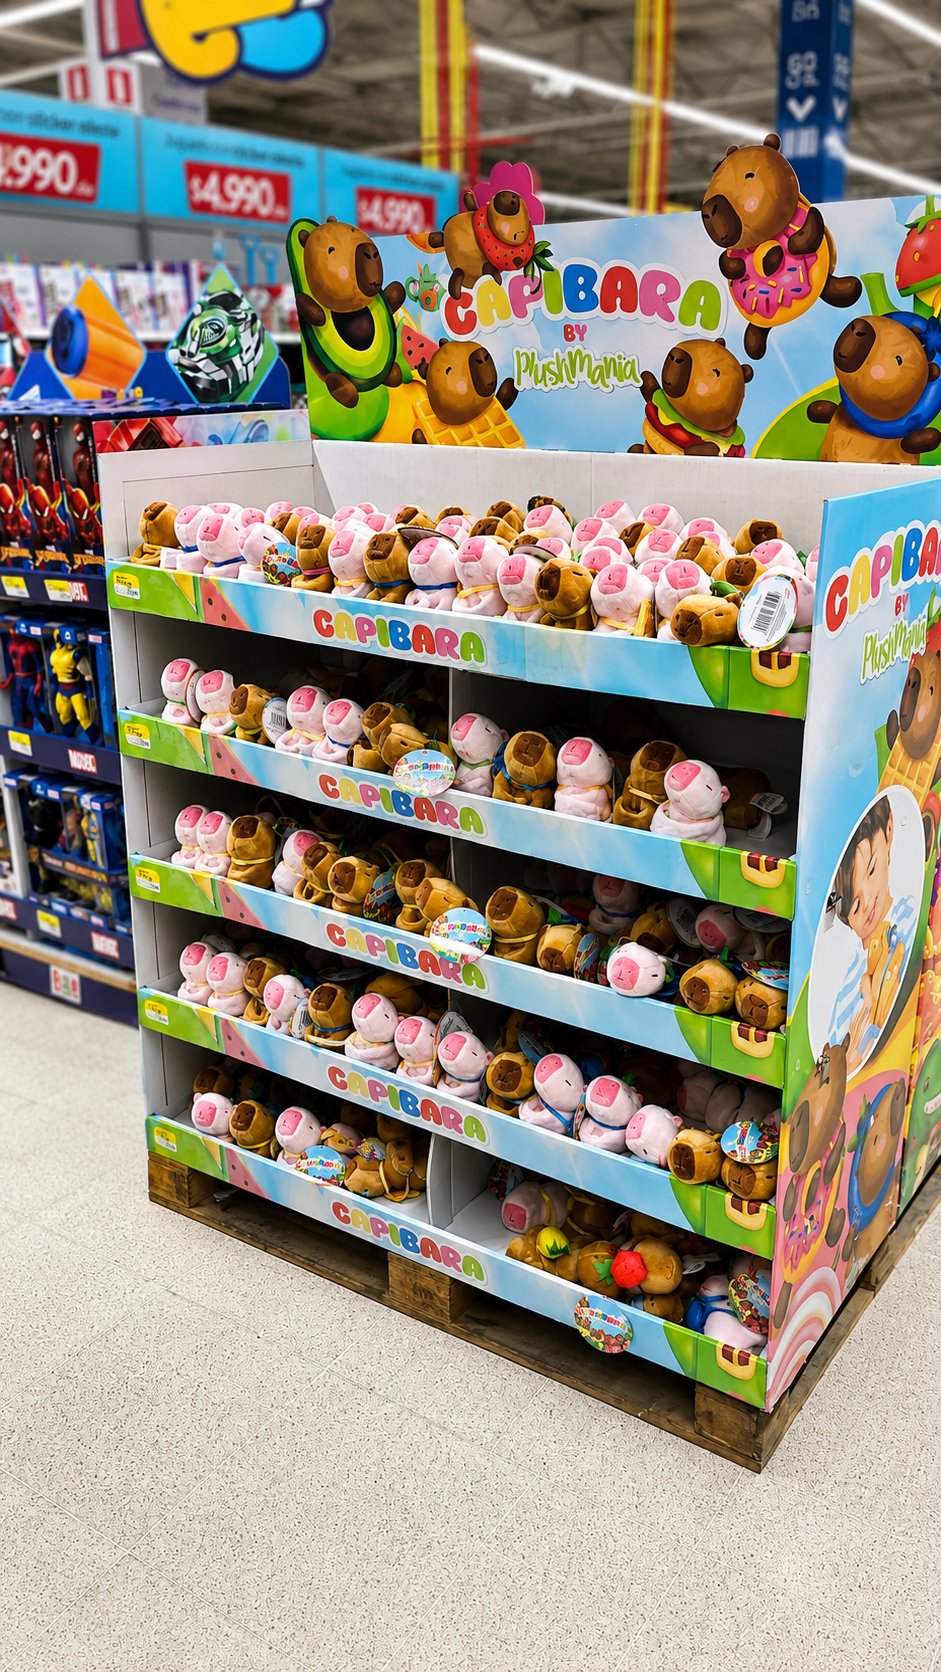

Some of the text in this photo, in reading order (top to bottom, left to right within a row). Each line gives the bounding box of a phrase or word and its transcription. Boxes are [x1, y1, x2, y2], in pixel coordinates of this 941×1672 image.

[444, 264, 721, 336] CAPIBARA
[563, 324, 587, 341] BY
[313, 609, 485, 663] CAPIBARA
[894, 593, 909, 617] BY
[318, 774, 484, 835] CAPIBARA
[326, 923, 486, 990] CAPIBARA
[327, 1065, 487, 1143] CAPIBARA
[332, 1201, 485, 1282] CAPIBARA
